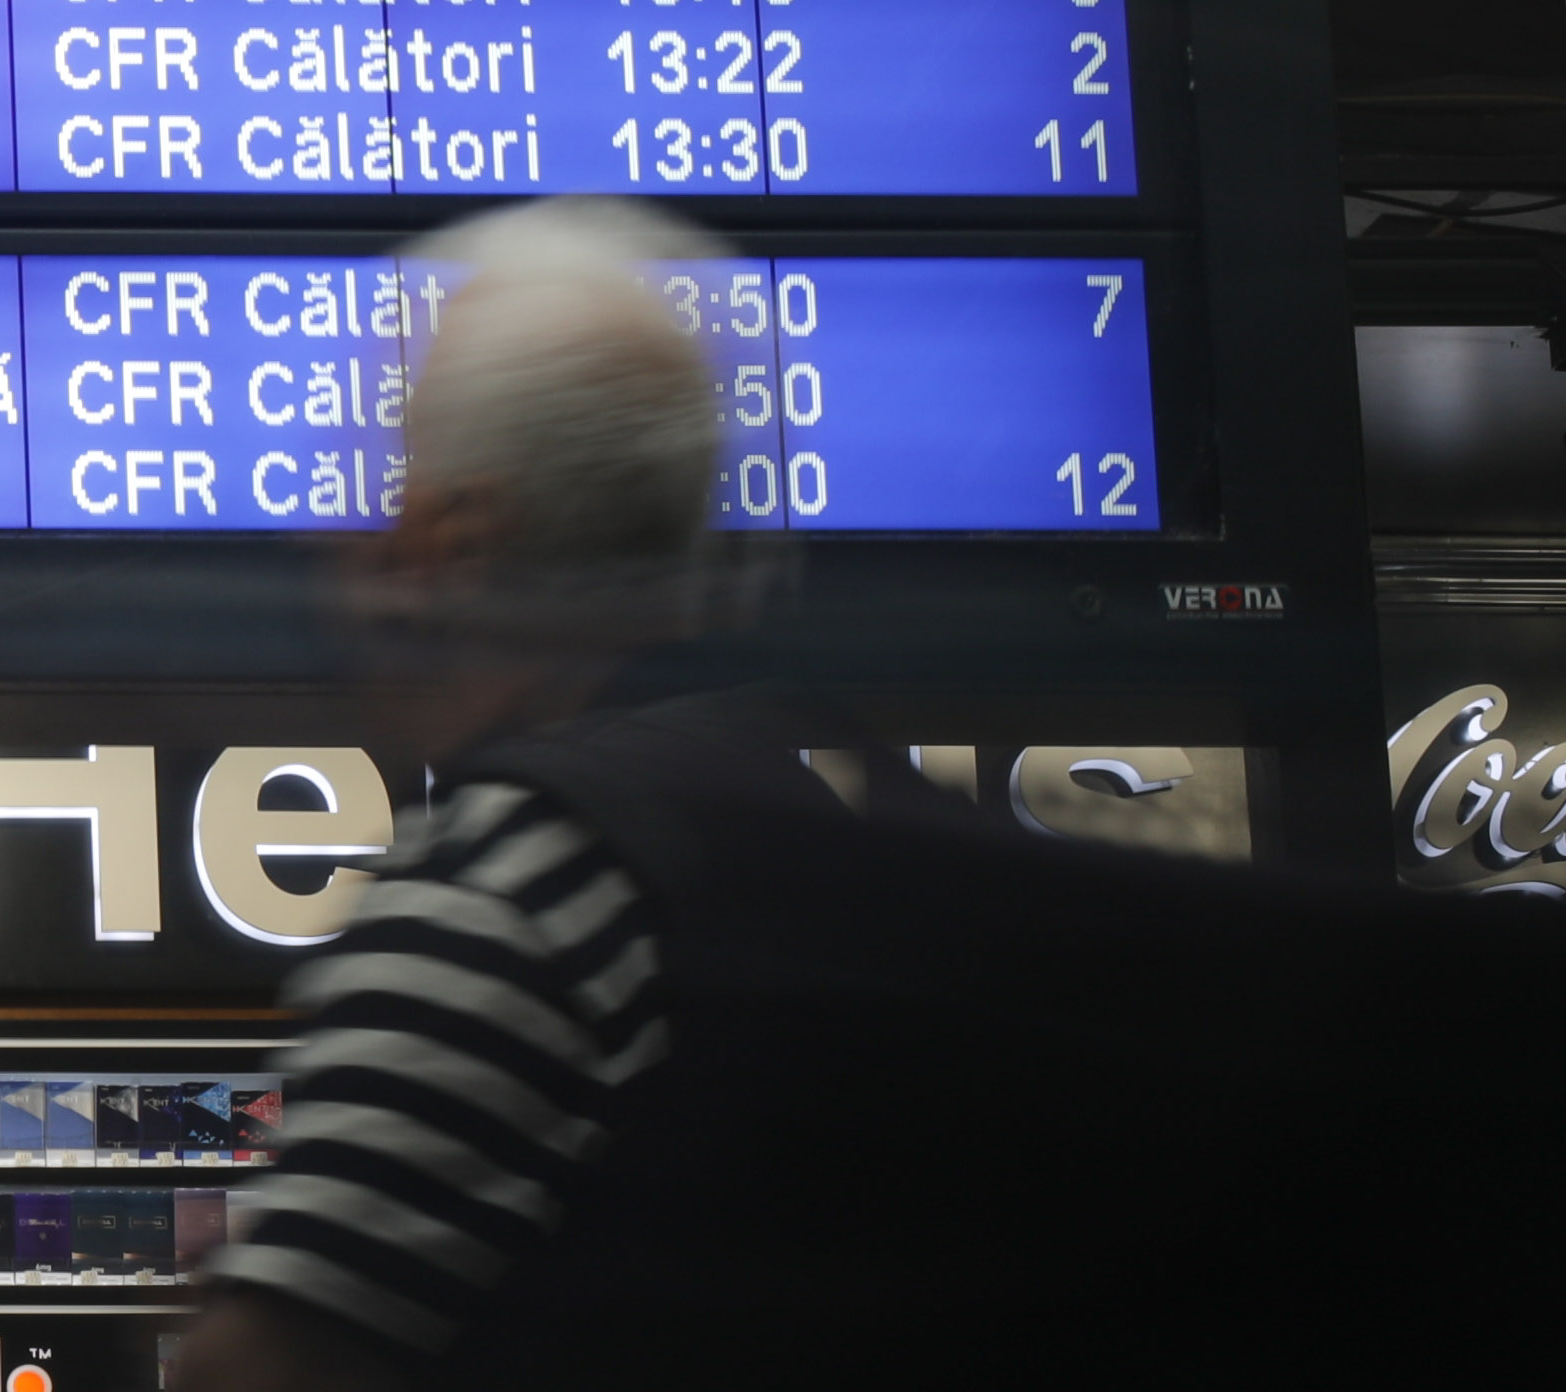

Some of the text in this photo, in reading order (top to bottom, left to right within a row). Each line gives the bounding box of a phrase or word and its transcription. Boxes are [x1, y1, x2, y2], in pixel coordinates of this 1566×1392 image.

[58, 114, 202, 179] CFR
[237, 112, 539, 181] Călători
[612, 118, 807, 181] 13:30
[1035, 119, 1107, 182] 11
[65, 272, 209, 336] CFR
[637, 274, 817, 337] 3:50
[1087, 276, 1122, 337] 7
[71, 450, 216, 514] CFR
[252, 450, 407, 515] Călă
[722, 452, 827, 515] :00
[1056, 453, 1137, 515] 12
